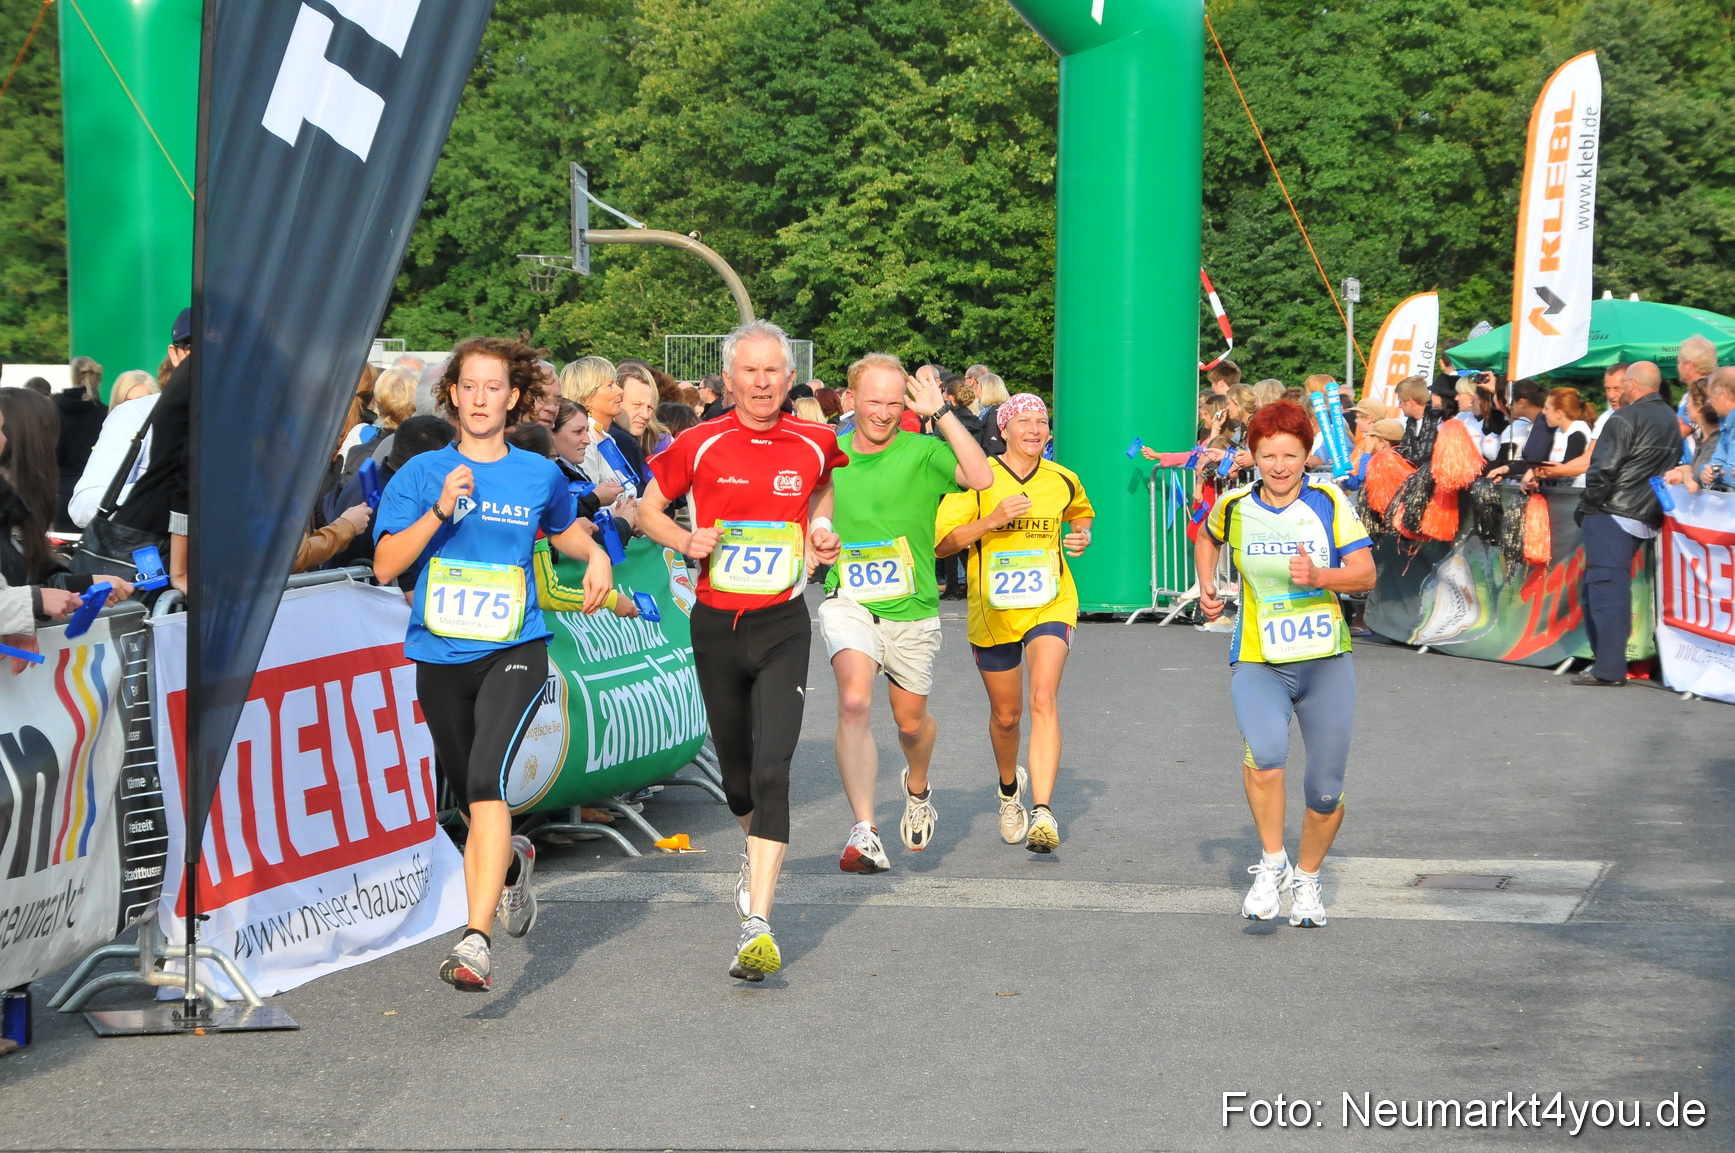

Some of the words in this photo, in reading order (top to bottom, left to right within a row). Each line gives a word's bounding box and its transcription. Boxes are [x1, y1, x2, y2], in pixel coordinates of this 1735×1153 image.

[1577, 105, 1600, 231] www.klebl.de
[1539, 90, 1577, 273] KLEBL
[458, 498, 468, 510] R
[481, 501, 531, 519] PLAST
[1025, 532, 1054, 540] Germany
[1250, 532, 1290, 541] TEAM
[721, 545, 783, 575] 757
[729, 574, 750, 583] Horst
[848, 560, 900, 588] 862
[994, 569, 1043, 595] 223
[1671, 530, 1735, 636] ME
[433, 586, 511, 620] 1175
[852, 586, 888, 595] Christopher
[440, 617, 482, 628] Magdalena
[1263, 613, 1332, 645] 1045
[124, 865, 162, 882] Stadtbusse
